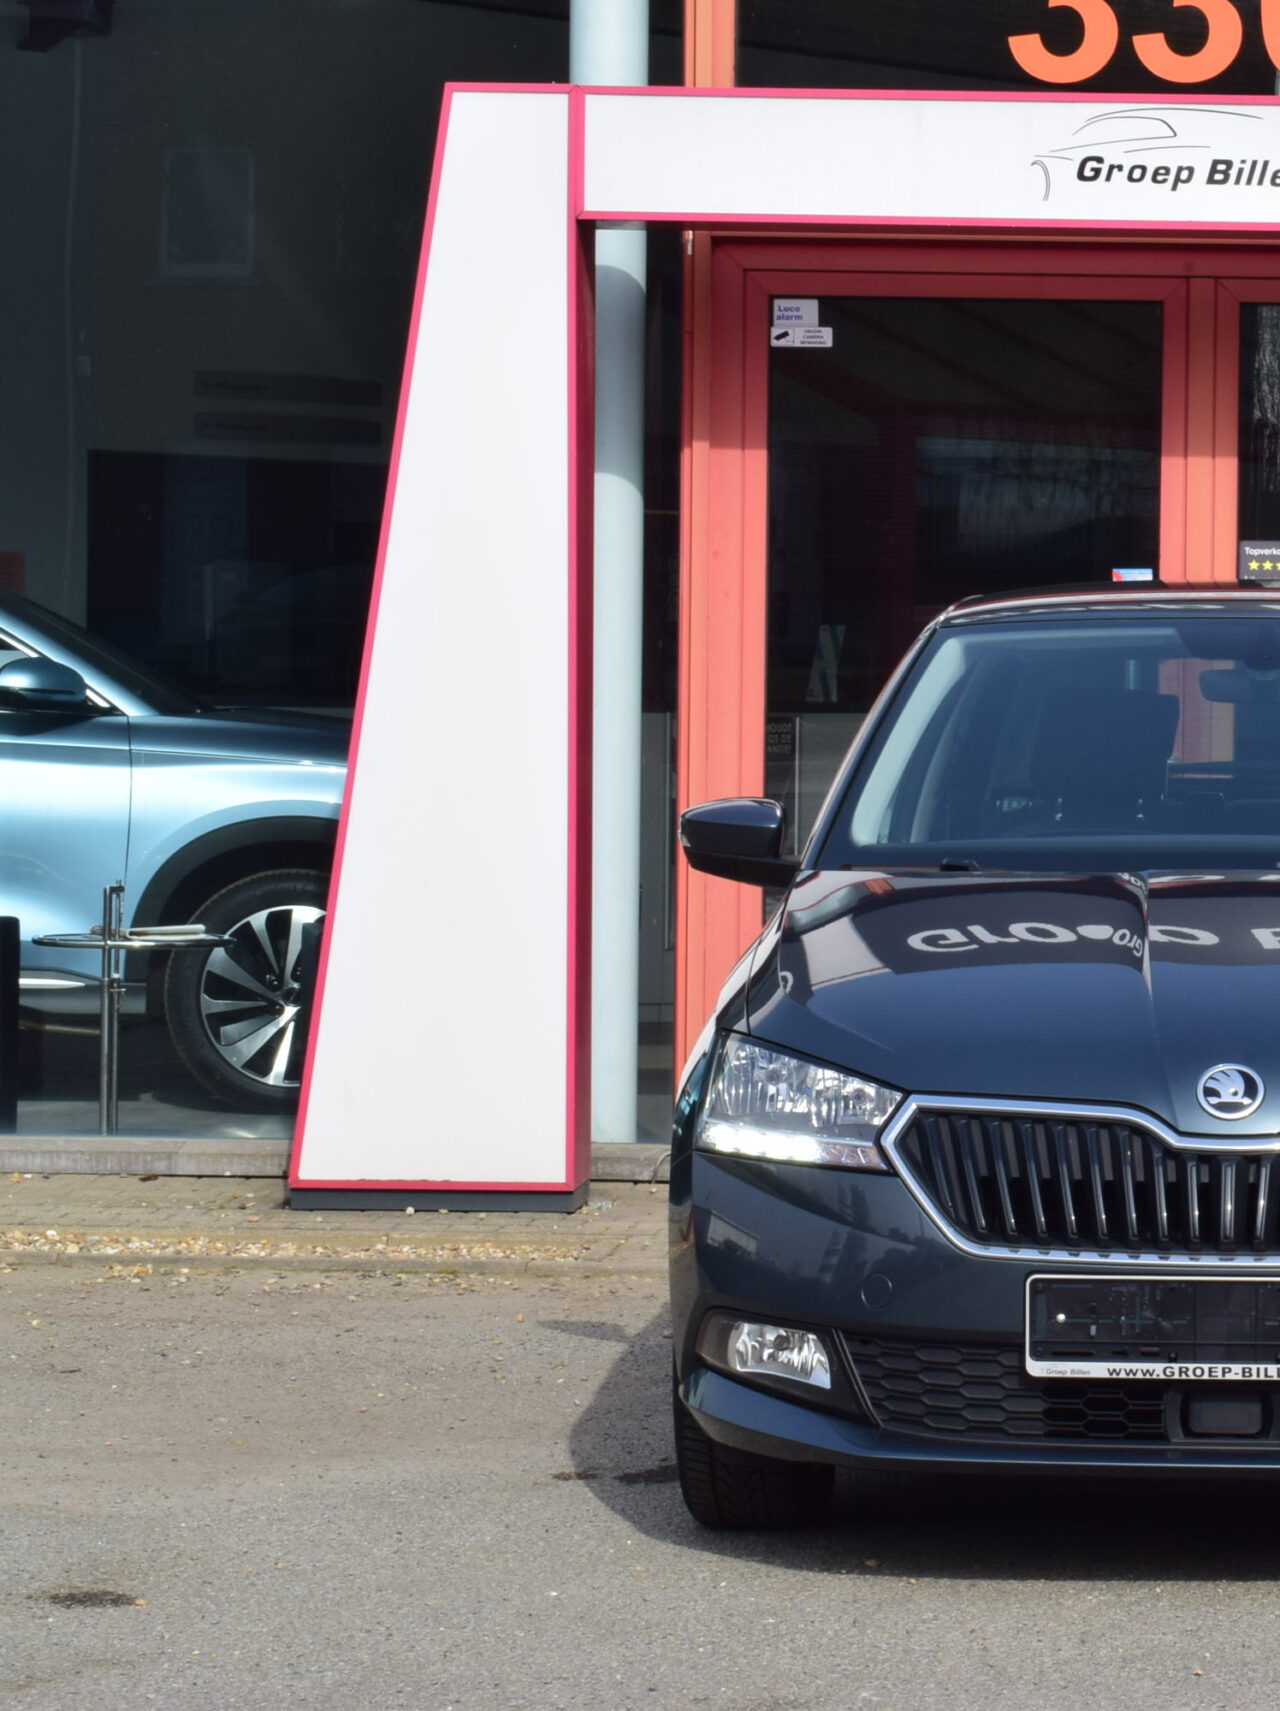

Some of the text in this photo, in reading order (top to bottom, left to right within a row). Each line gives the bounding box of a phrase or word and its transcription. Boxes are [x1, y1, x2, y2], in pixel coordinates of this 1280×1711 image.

[1076, 155, 1196, 192] Groep
[777, 305, 801, 313] Luco
[776, 313, 803, 321] alarm
[1046, 1367, 1068, 1376] Groep
